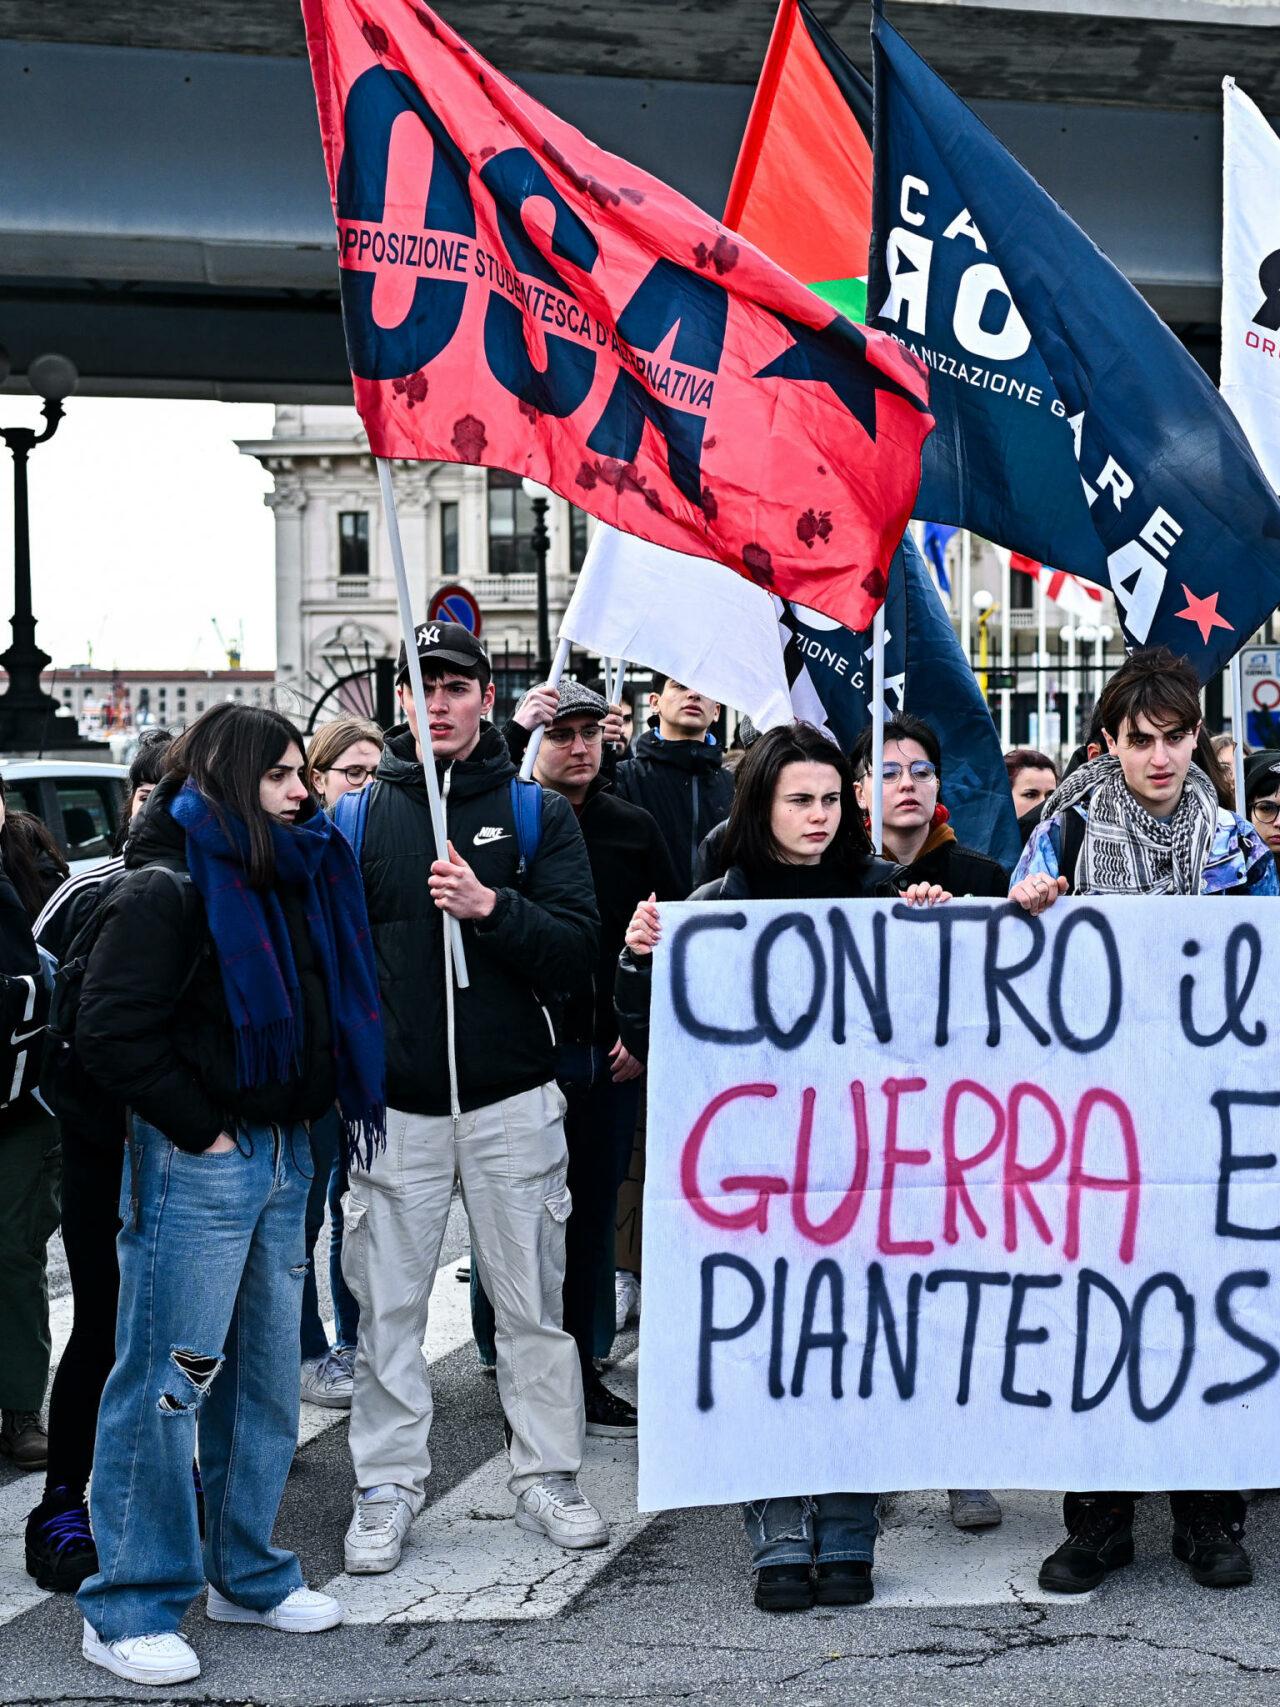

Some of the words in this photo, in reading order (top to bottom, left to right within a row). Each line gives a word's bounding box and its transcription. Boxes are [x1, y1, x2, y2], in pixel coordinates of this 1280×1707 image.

[479, 827, 504, 838] NIKE
[669, 904, 1123, 1053] CONTRO
[1179, 921, 1268, 1048] il
[680, 1076, 1144, 1265] GUERRA
